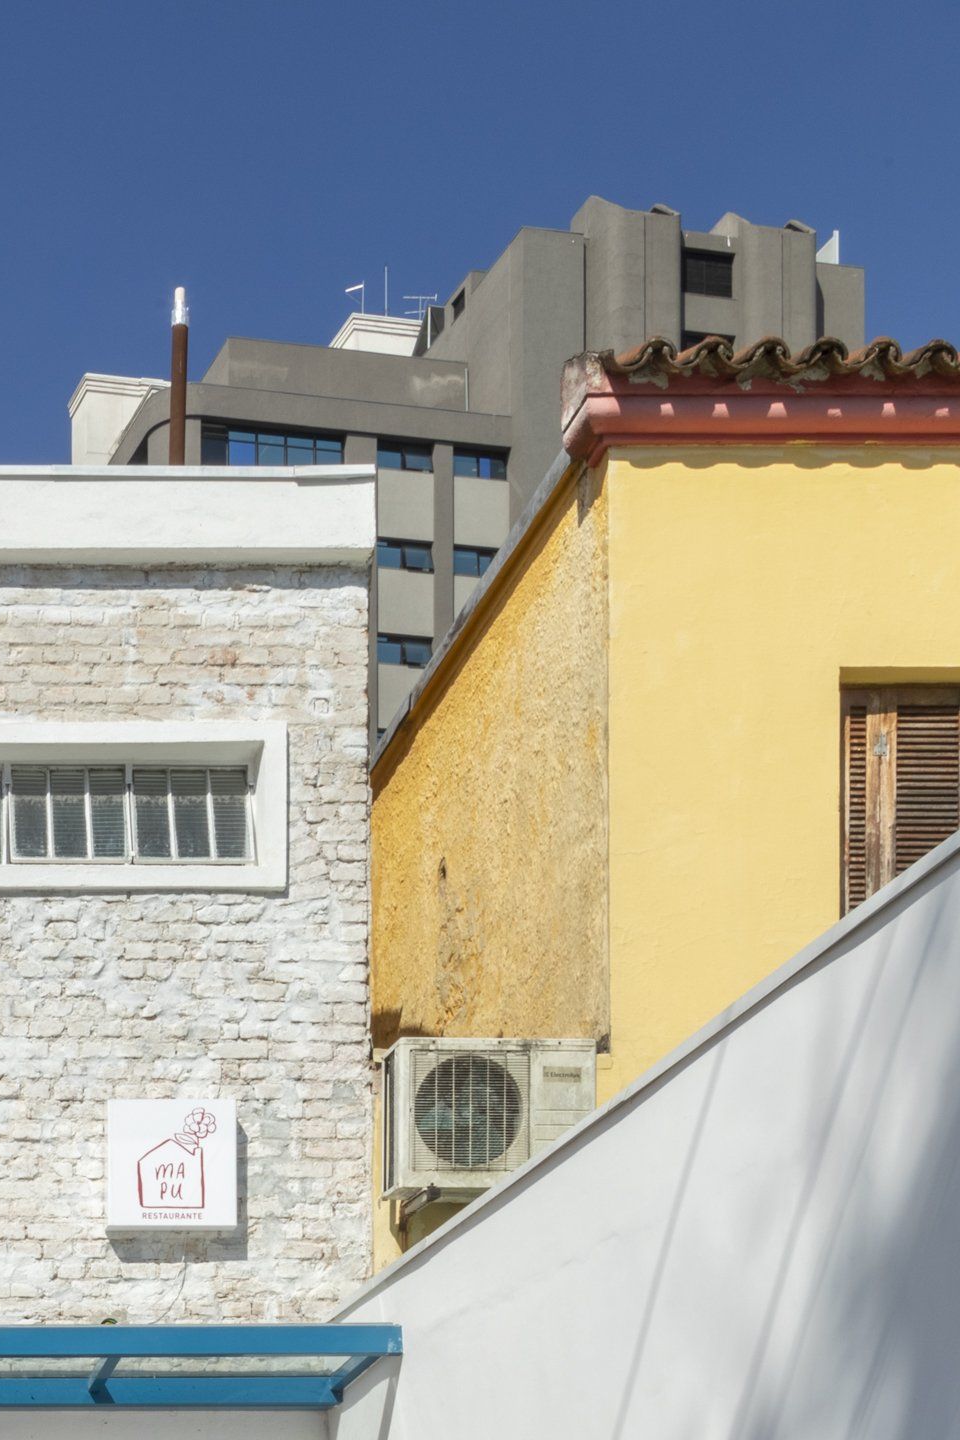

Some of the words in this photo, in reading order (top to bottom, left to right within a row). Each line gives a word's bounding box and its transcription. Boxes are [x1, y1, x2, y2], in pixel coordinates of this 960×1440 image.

[155, 1162, 185, 1180] MA
[160, 1181, 183, 1200] PU
[142, 1212, 203, 1220] RESTAURANTE
